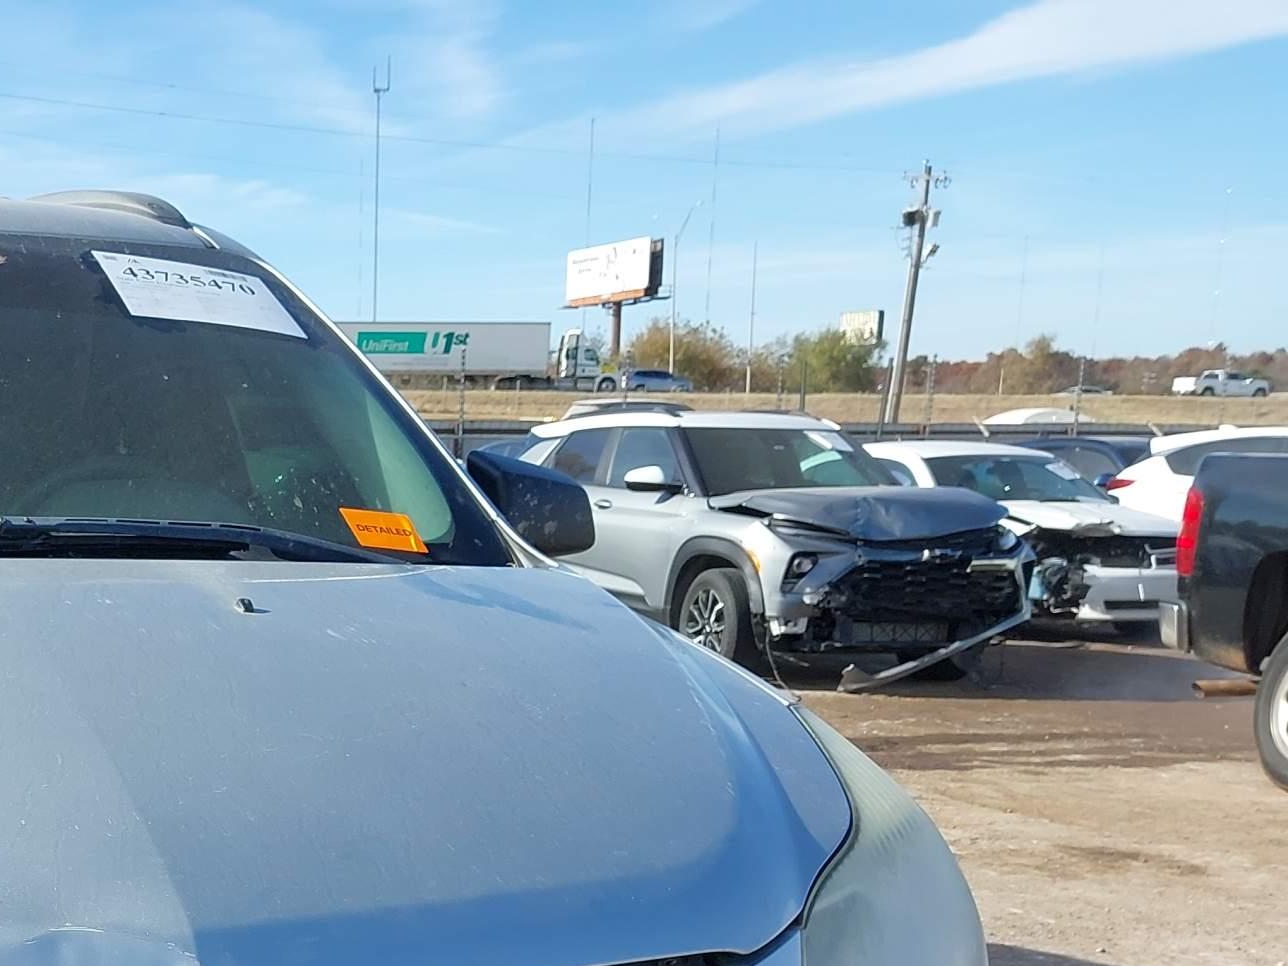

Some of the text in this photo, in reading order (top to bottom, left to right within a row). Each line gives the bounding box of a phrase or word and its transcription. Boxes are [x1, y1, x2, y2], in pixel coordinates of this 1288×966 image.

[122, 267, 256, 295] 43735470
[362, 338, 409, 353] UniFirst
[355, 523, 412, 537] DETAILED
